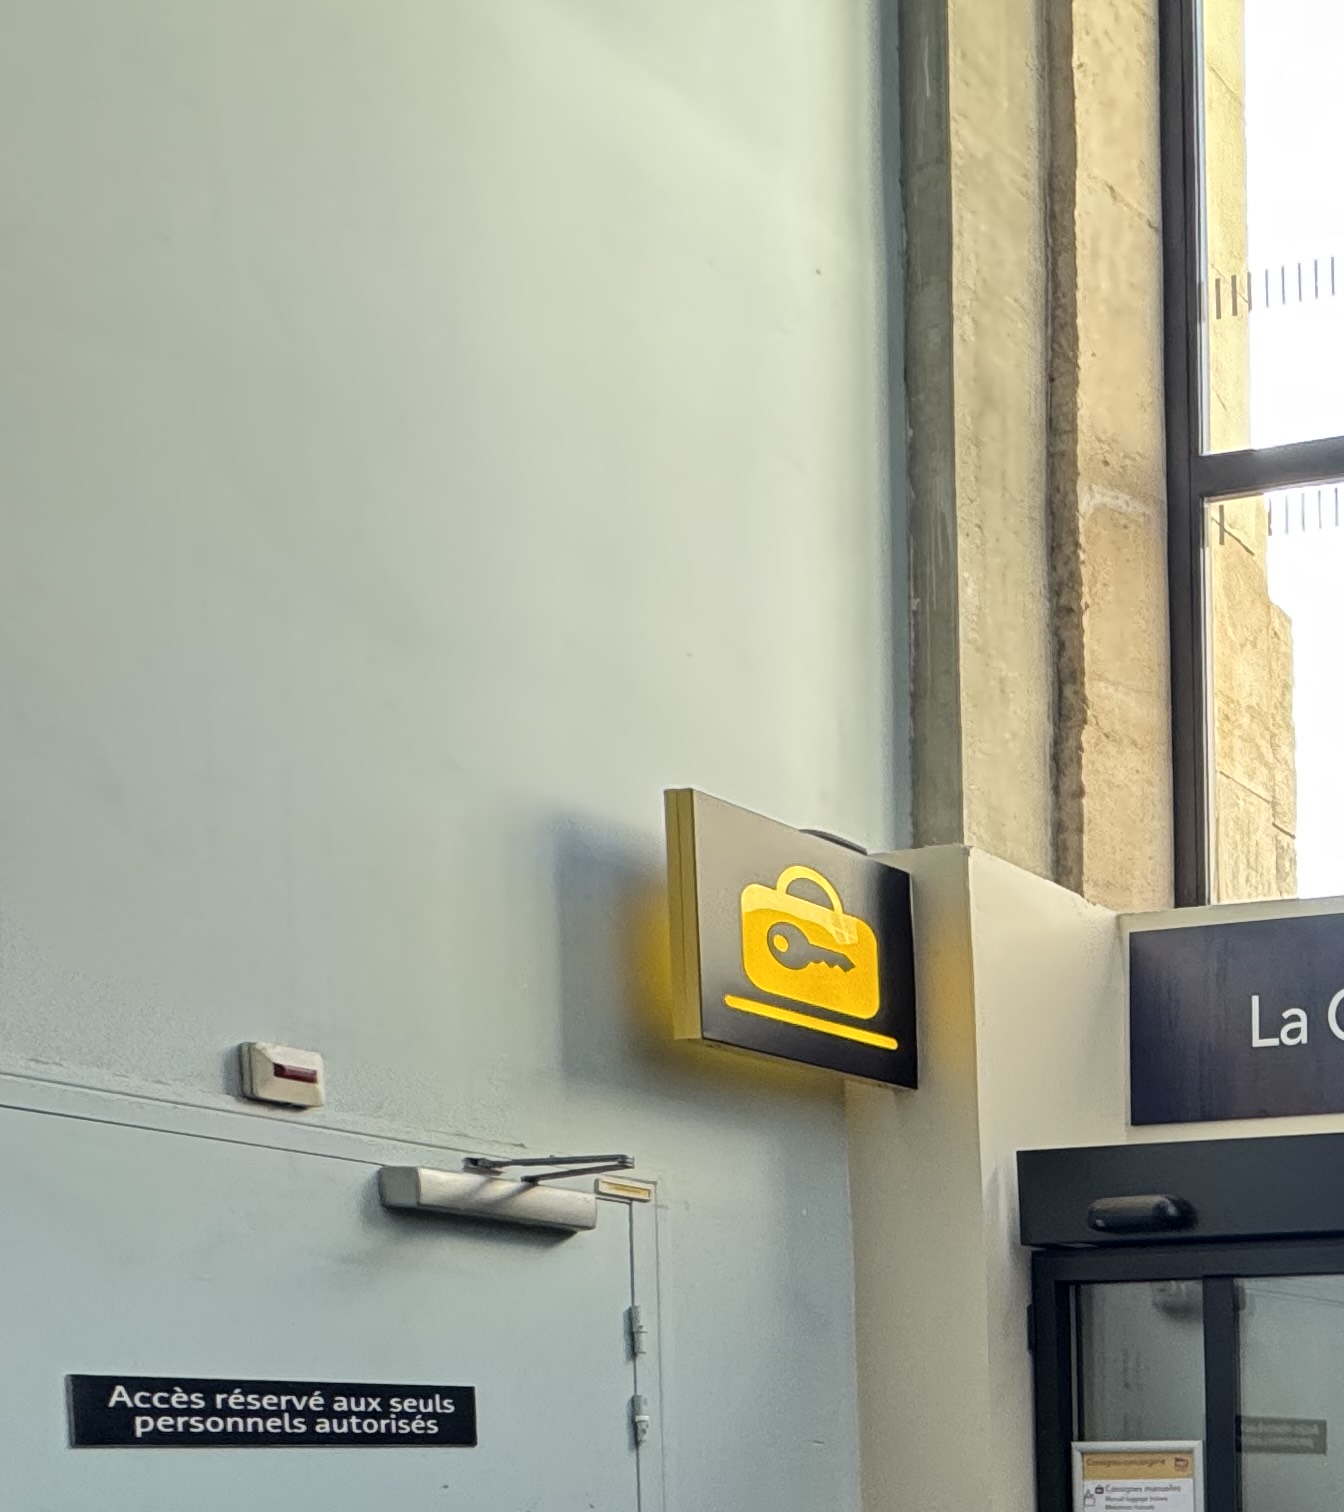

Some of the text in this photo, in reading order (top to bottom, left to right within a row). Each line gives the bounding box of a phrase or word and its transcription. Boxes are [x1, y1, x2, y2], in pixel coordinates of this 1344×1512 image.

[1249, 995, 1308, 1048] La
[108, 1385, 455, 1414] Accès réservé aux seuls
[134, 1411, 439, 1437] personnels autorisés
